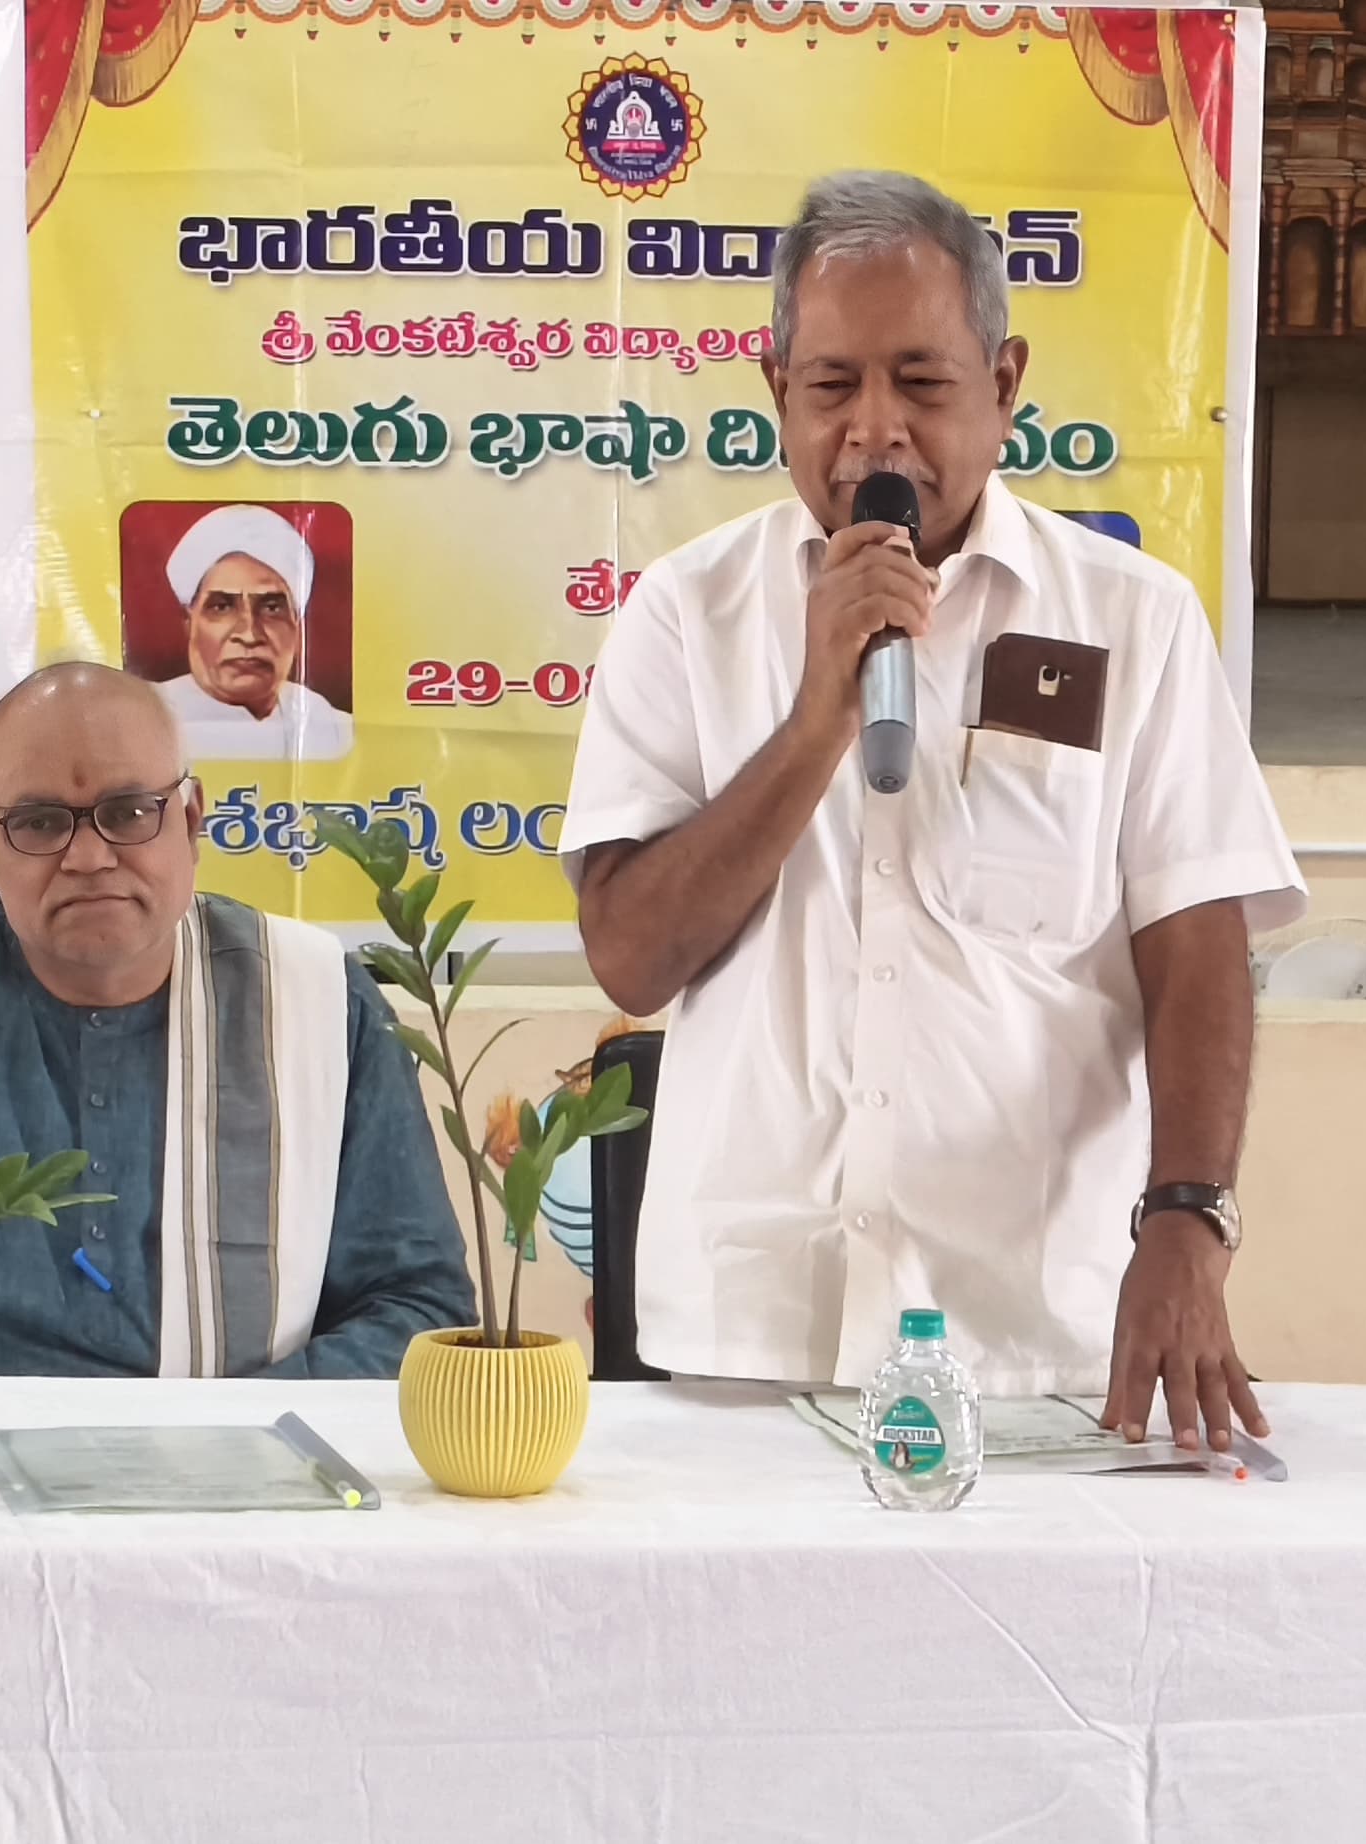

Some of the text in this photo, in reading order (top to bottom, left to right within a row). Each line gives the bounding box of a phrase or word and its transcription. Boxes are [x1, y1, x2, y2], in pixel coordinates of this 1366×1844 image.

[178, 198, 602, 283] భారతీయ
[261, 310, 315, 363] శ్రీ
[324, 309, 570, 370] వేంకటేశ్వర
[166, 394, 448, 467] తెలుగు
[471, 400, 688, 482] భాషా
[405, 660, 596, 706] 29-0
